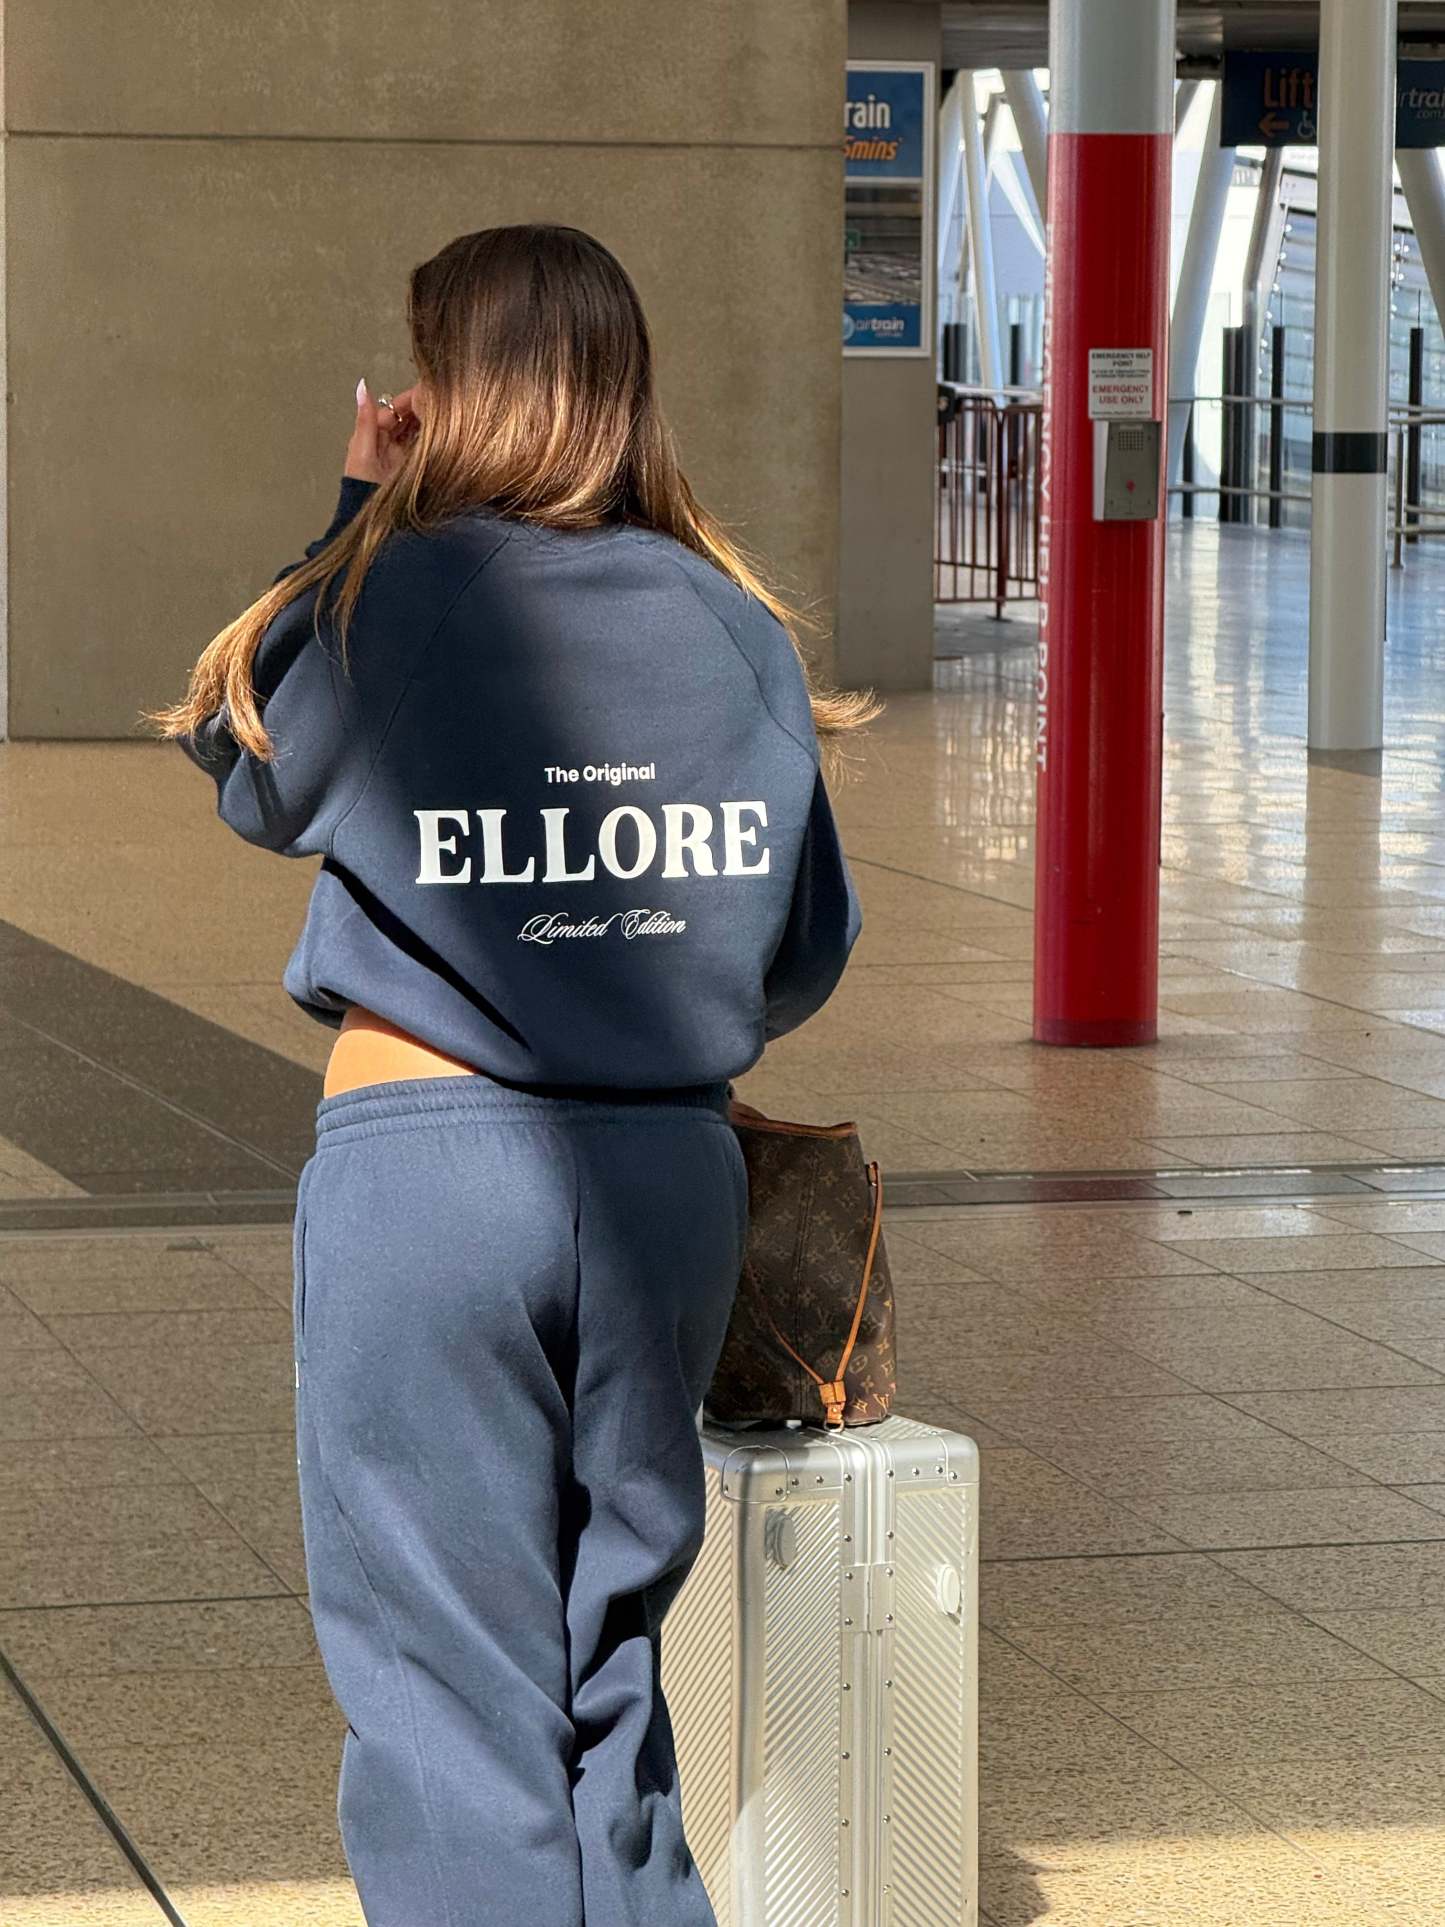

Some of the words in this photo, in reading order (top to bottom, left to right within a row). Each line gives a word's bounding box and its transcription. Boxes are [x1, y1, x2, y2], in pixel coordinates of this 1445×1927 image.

[1263, 67, 1313, 109] Lift
[1092, 385, 1149, 393] EMERGENCY
[1099, 396, 1118, 404] USE
[1120, 396, 1144, 404] ONLY
[544, 767, 579, 784] The
[583, 763, 655, 786] Original
[413, 801, 770, 884] ELLORE
[517, 912, 616, 944] Limited
[620, 909, 687, 940] Edition
